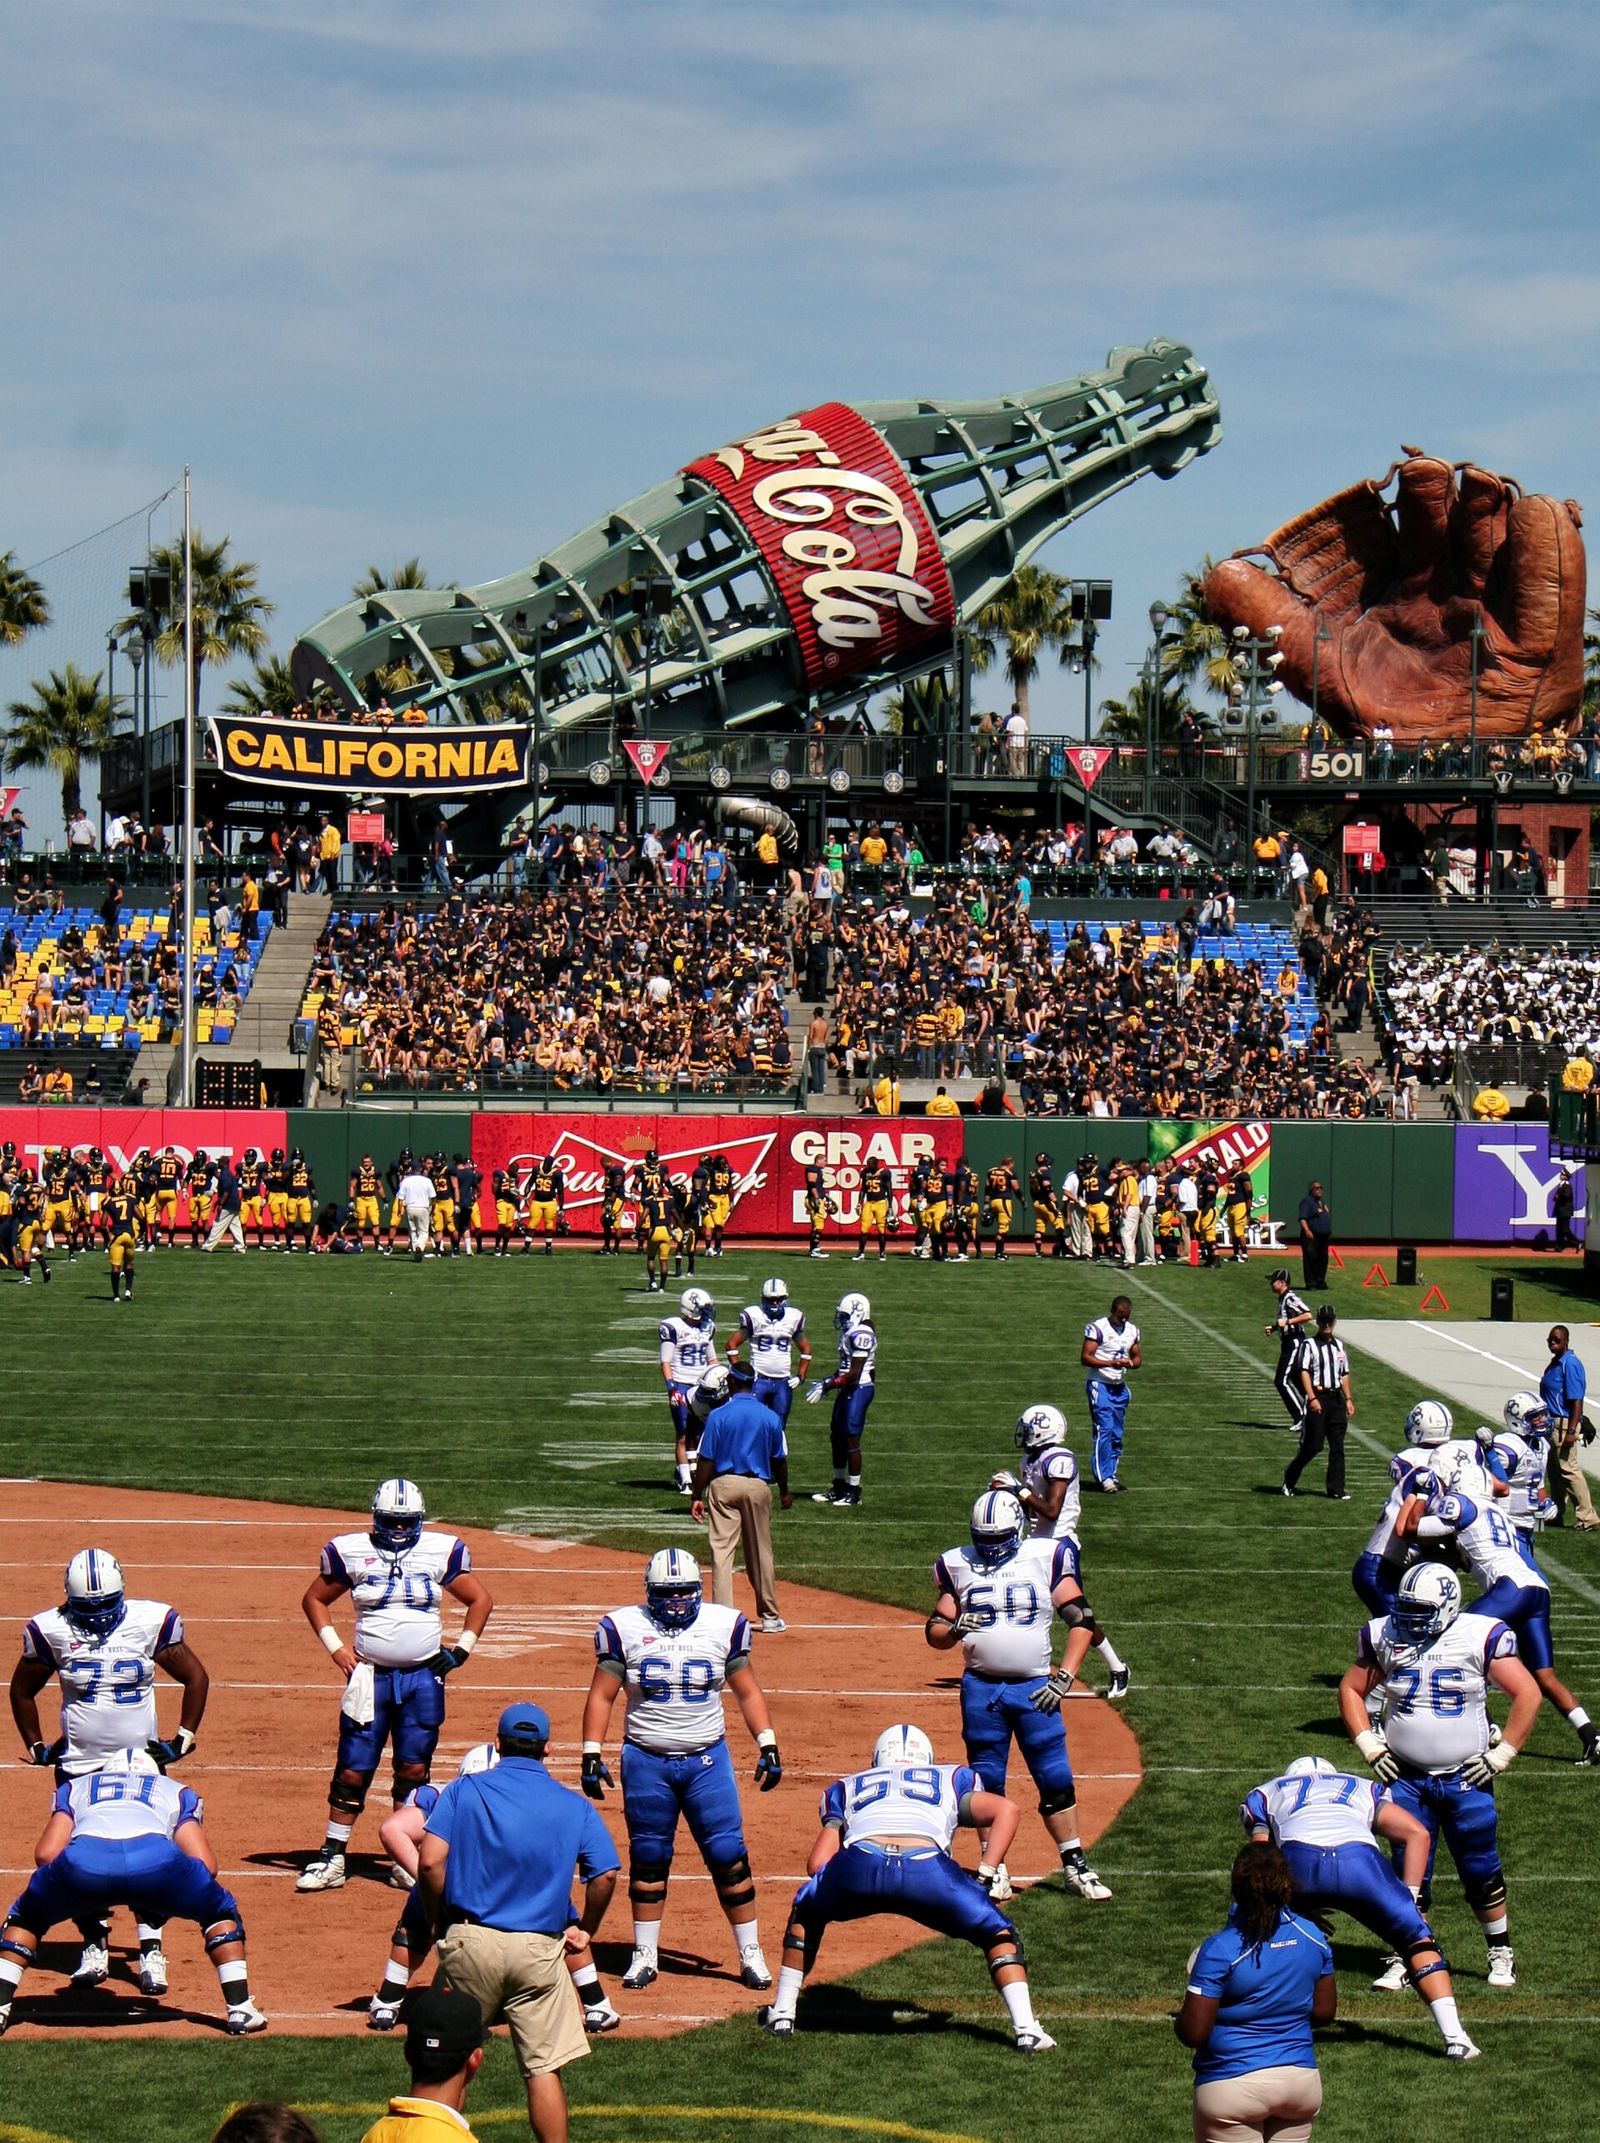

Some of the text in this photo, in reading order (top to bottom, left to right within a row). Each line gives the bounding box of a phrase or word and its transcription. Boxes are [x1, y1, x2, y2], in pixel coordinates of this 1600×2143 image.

[226, 730, 519, 778] CALIFORNIA
[1310, 752, 1362, 778] 501
[203, 1065, 255, 1106] 25
[790, 1131, 935, 1166] GRAB
[1182, 1122, 1270, 1175] RALD
[822, 1167, 909, 1189] SOE
[115, 1200, 127, 1220] 7
[657, 1202, 666, 1219] 1
[1031, 1411, 1051, 1429] PC
[365, 1573, 438, 1612] 70
[967, 1580, 1038, 1628] 50
[70, 1659, 145, 1704] 72
[639, 1657, 714, 1704] 60
[1392, 1668, 1465, 1718] 76
[88, 1773, 158, 1807] 61
[851, 1767, 943, 1813] 59
[1275, 1773, 1359, 1816] 77
